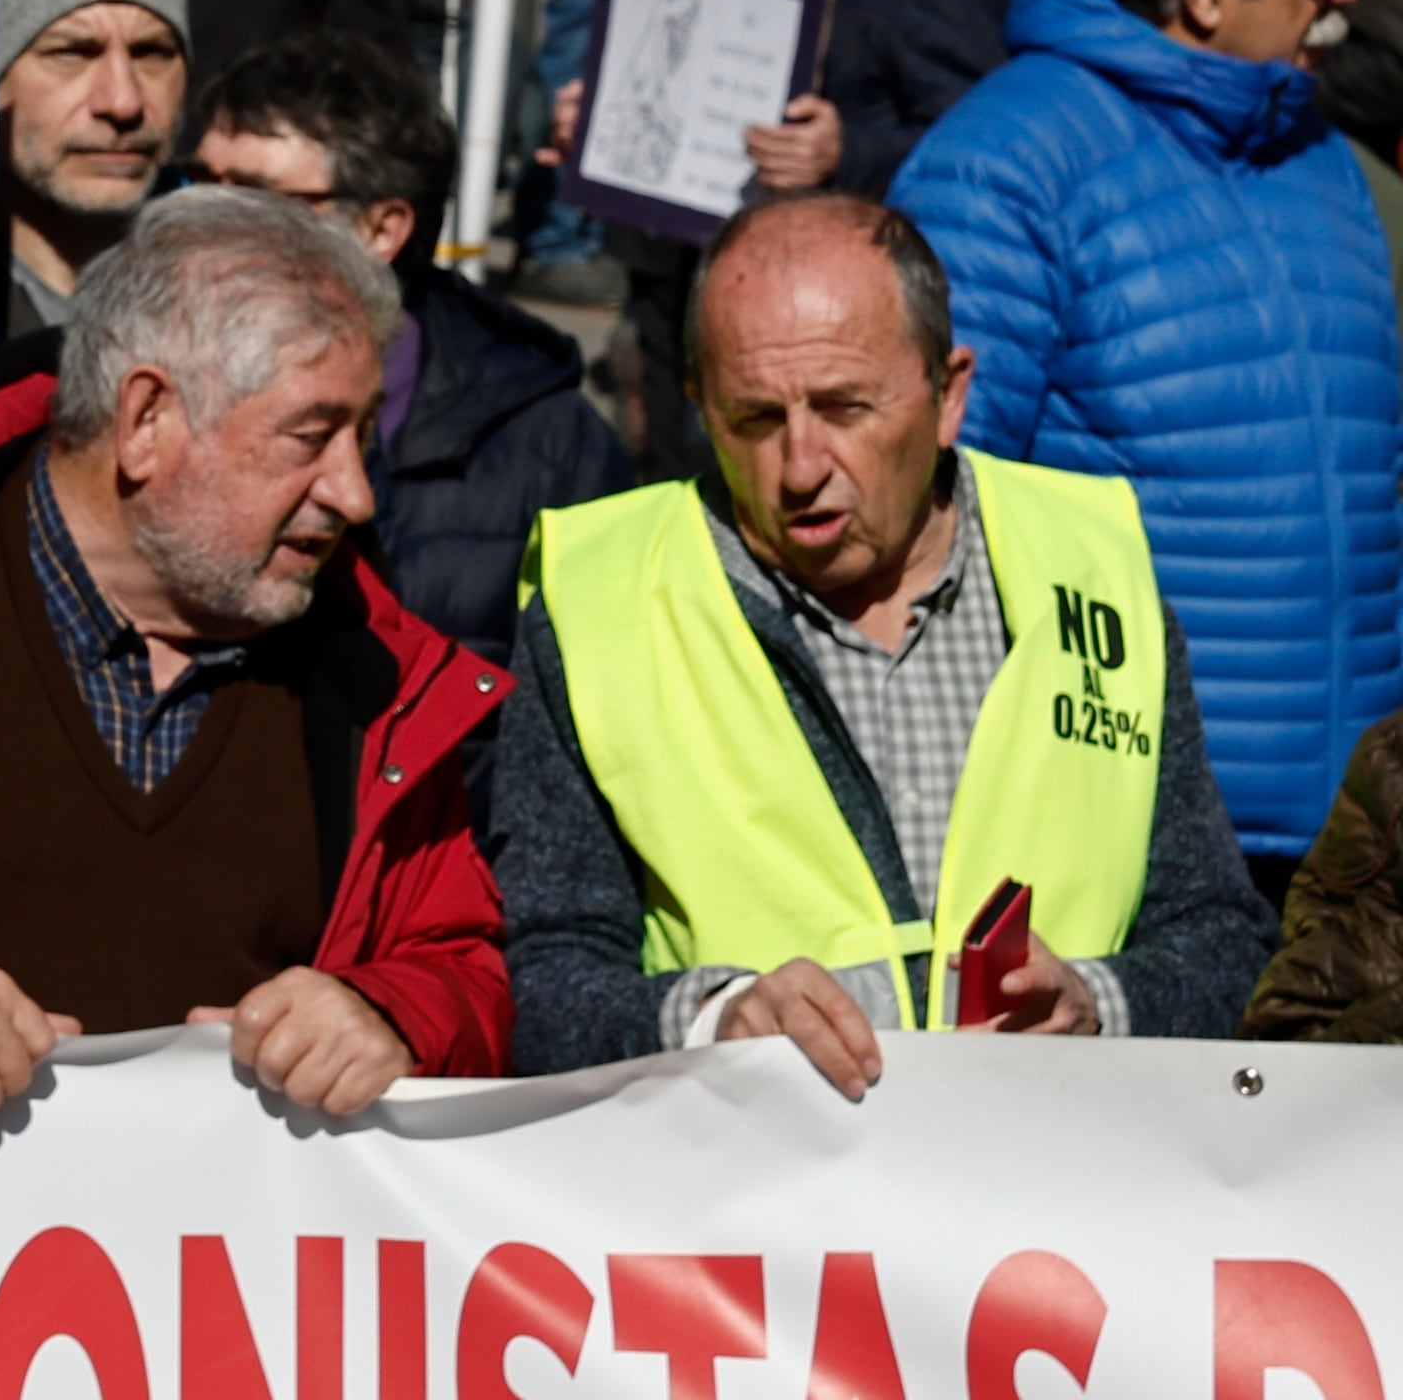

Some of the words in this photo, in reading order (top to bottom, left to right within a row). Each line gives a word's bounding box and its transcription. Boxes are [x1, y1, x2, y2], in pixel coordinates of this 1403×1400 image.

[1053, 585, 1125, 670] NO
[1083, 663, 1106, 702] AL
[1053, 694, 1151, 757] 0,25%
